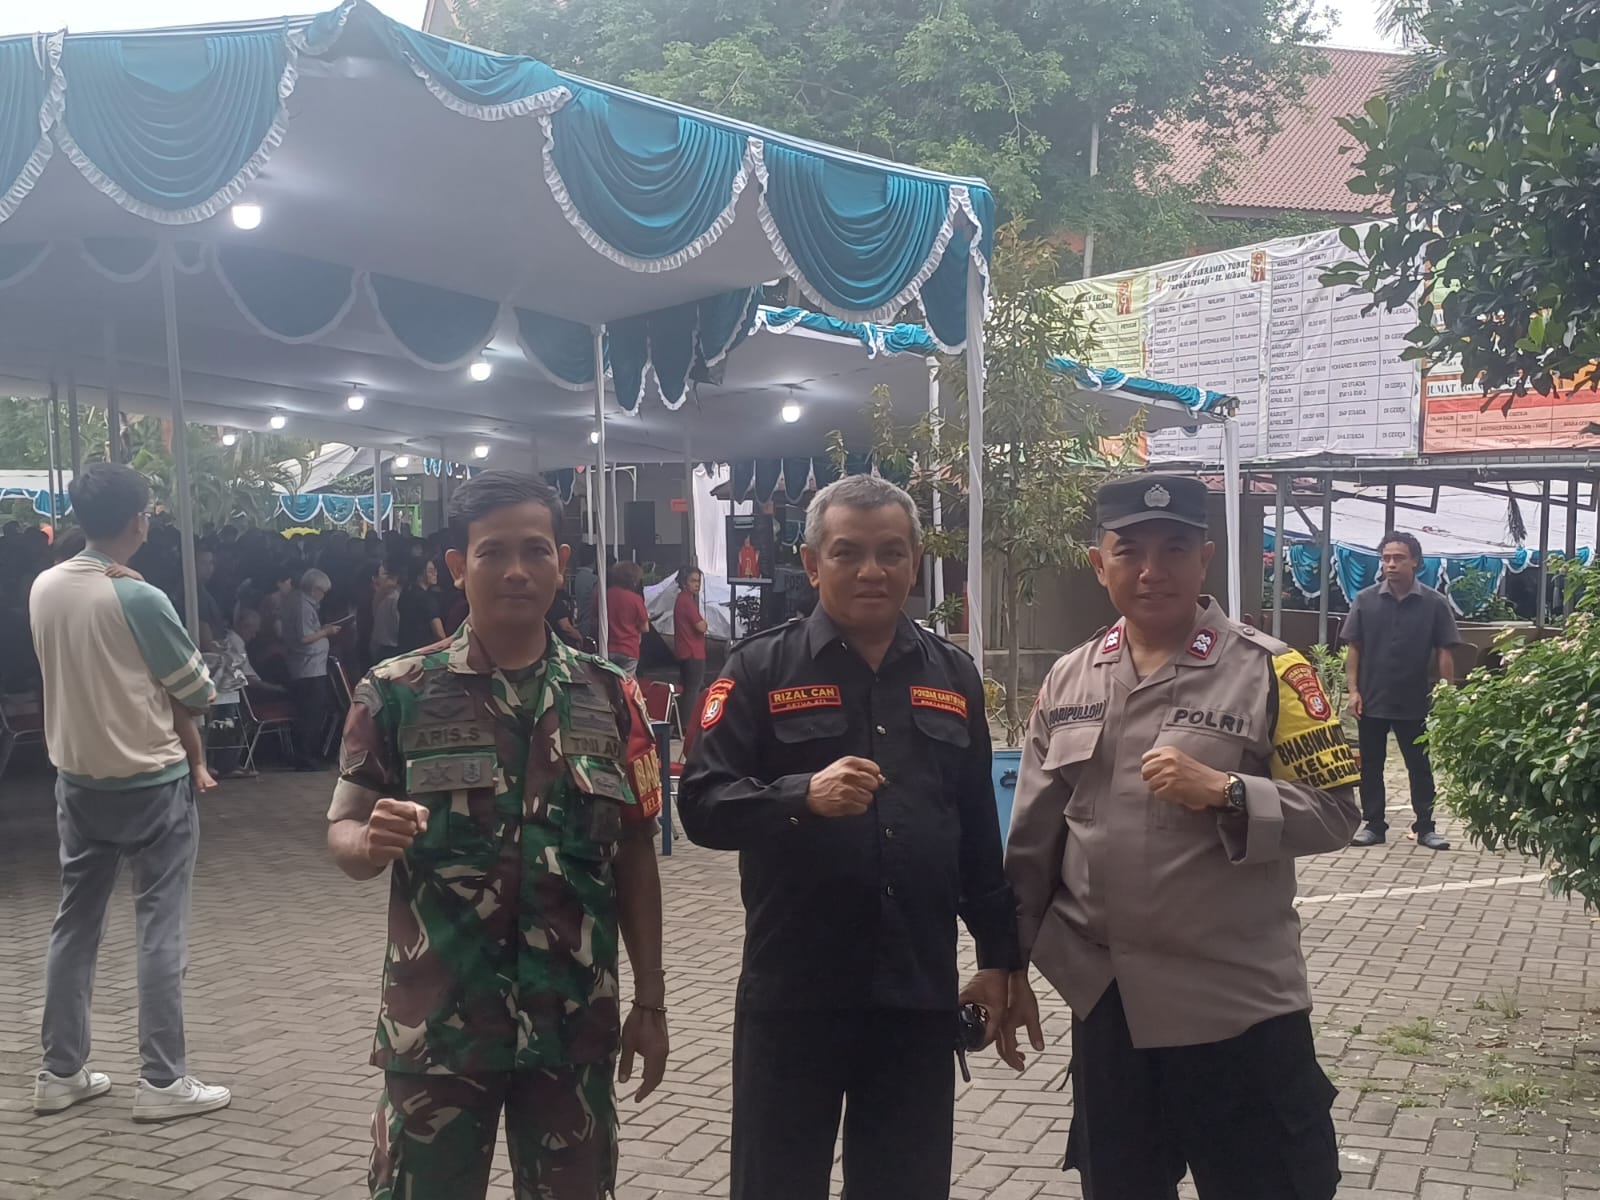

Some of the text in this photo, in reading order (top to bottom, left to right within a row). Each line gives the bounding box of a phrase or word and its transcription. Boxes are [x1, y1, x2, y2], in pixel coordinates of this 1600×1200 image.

[773, 690, 807, 703] RIZAL
[811, 688, 835, 697] CAN
[1173, 708, 1244, 734] POLRI
[570, 736, 599, 754] TNI
